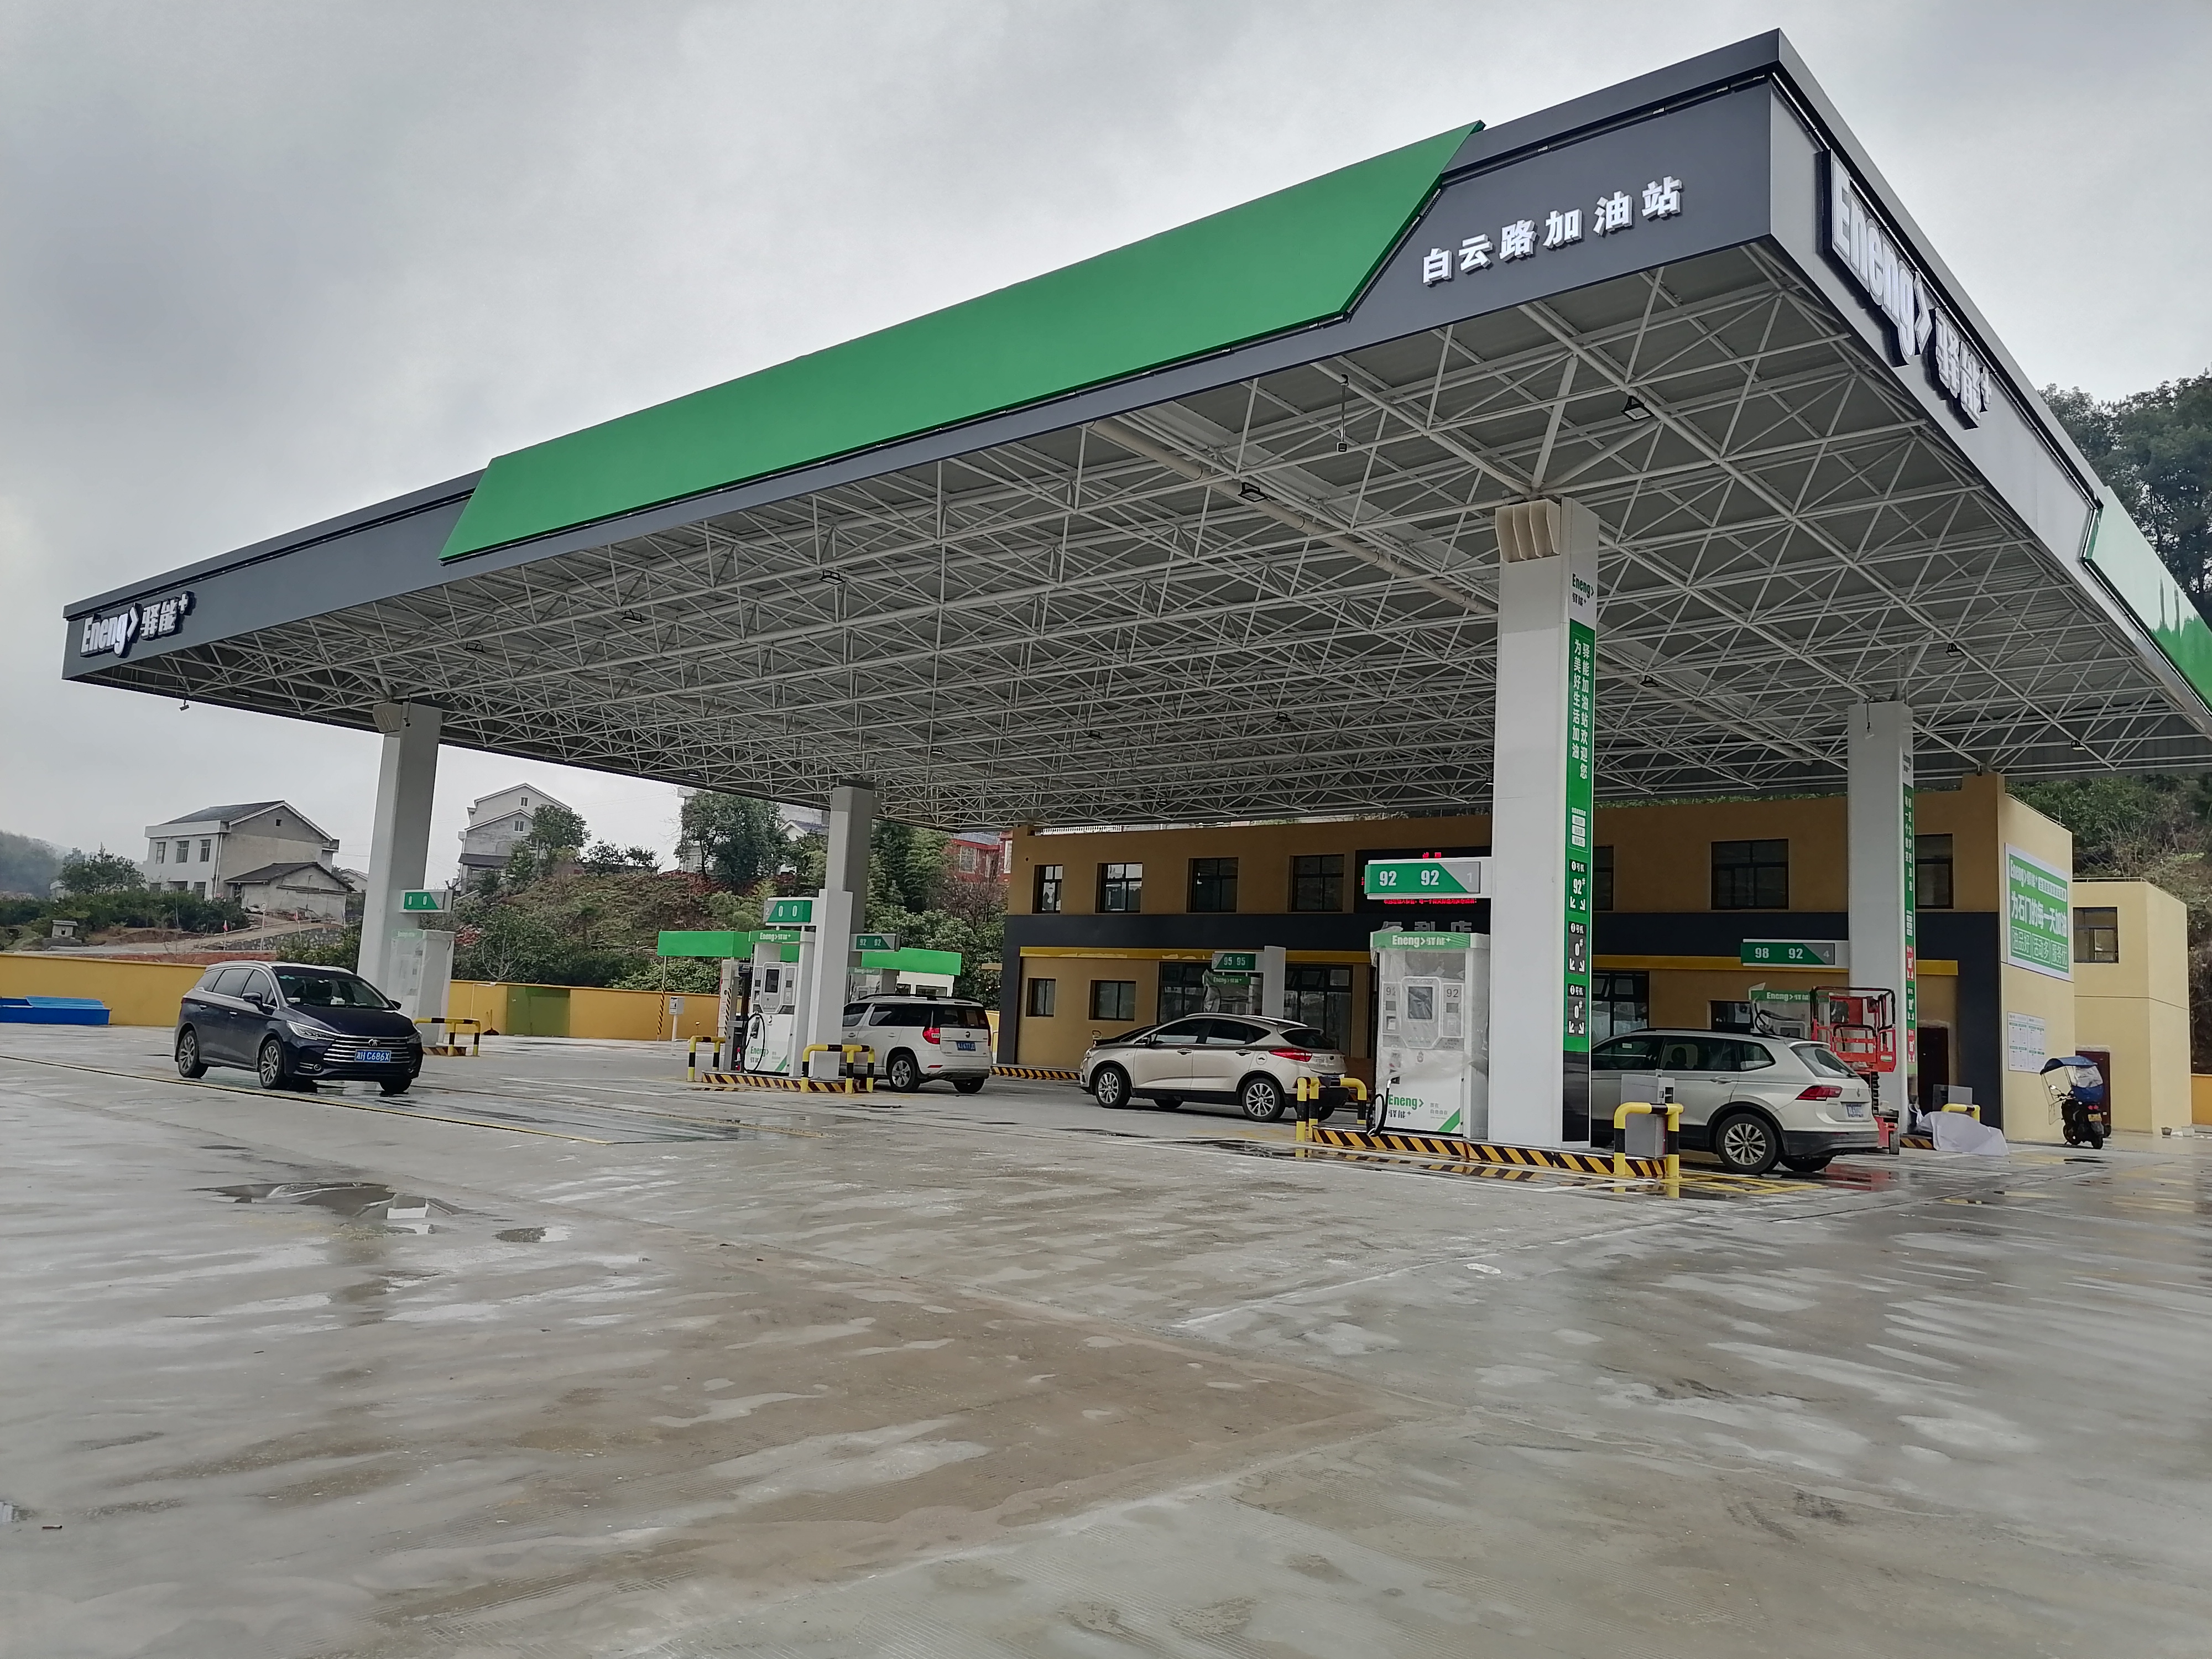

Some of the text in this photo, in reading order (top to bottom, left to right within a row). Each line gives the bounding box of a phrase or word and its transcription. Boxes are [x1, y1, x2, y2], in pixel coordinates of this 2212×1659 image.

[1422, 176, 1683, 285] 白云路加油站
[1833, 156, 1914, 357] Eneng
[1572, 573, 1590, 599] Eneng
[81, 613, 129, 655] Eneng
[1379, 871, 1397, 886] 92
[1421, 870, 1439, 885] 92
[1467, 872, 1472, 883] 1
[408, 896, 412, 905] 0
[423, 896, 427, 905] 0
[778, 905, 783, 917] 0
[792, 905, 797, 917] 0
[2011, 890, 2067, 938] 为石门的每一天加油
[1392, 935, 1420, 948] Eneng
[1755, 947, 1769, 958] 98
[1788, 948, 1803, 959] 92
[1224, 957, 1232, 966] 95
[1237, 957, 1245, 966] 95
[1447, 989, 1459, 998] 92
[1388, 1094, 1417, 1110] Eneng
